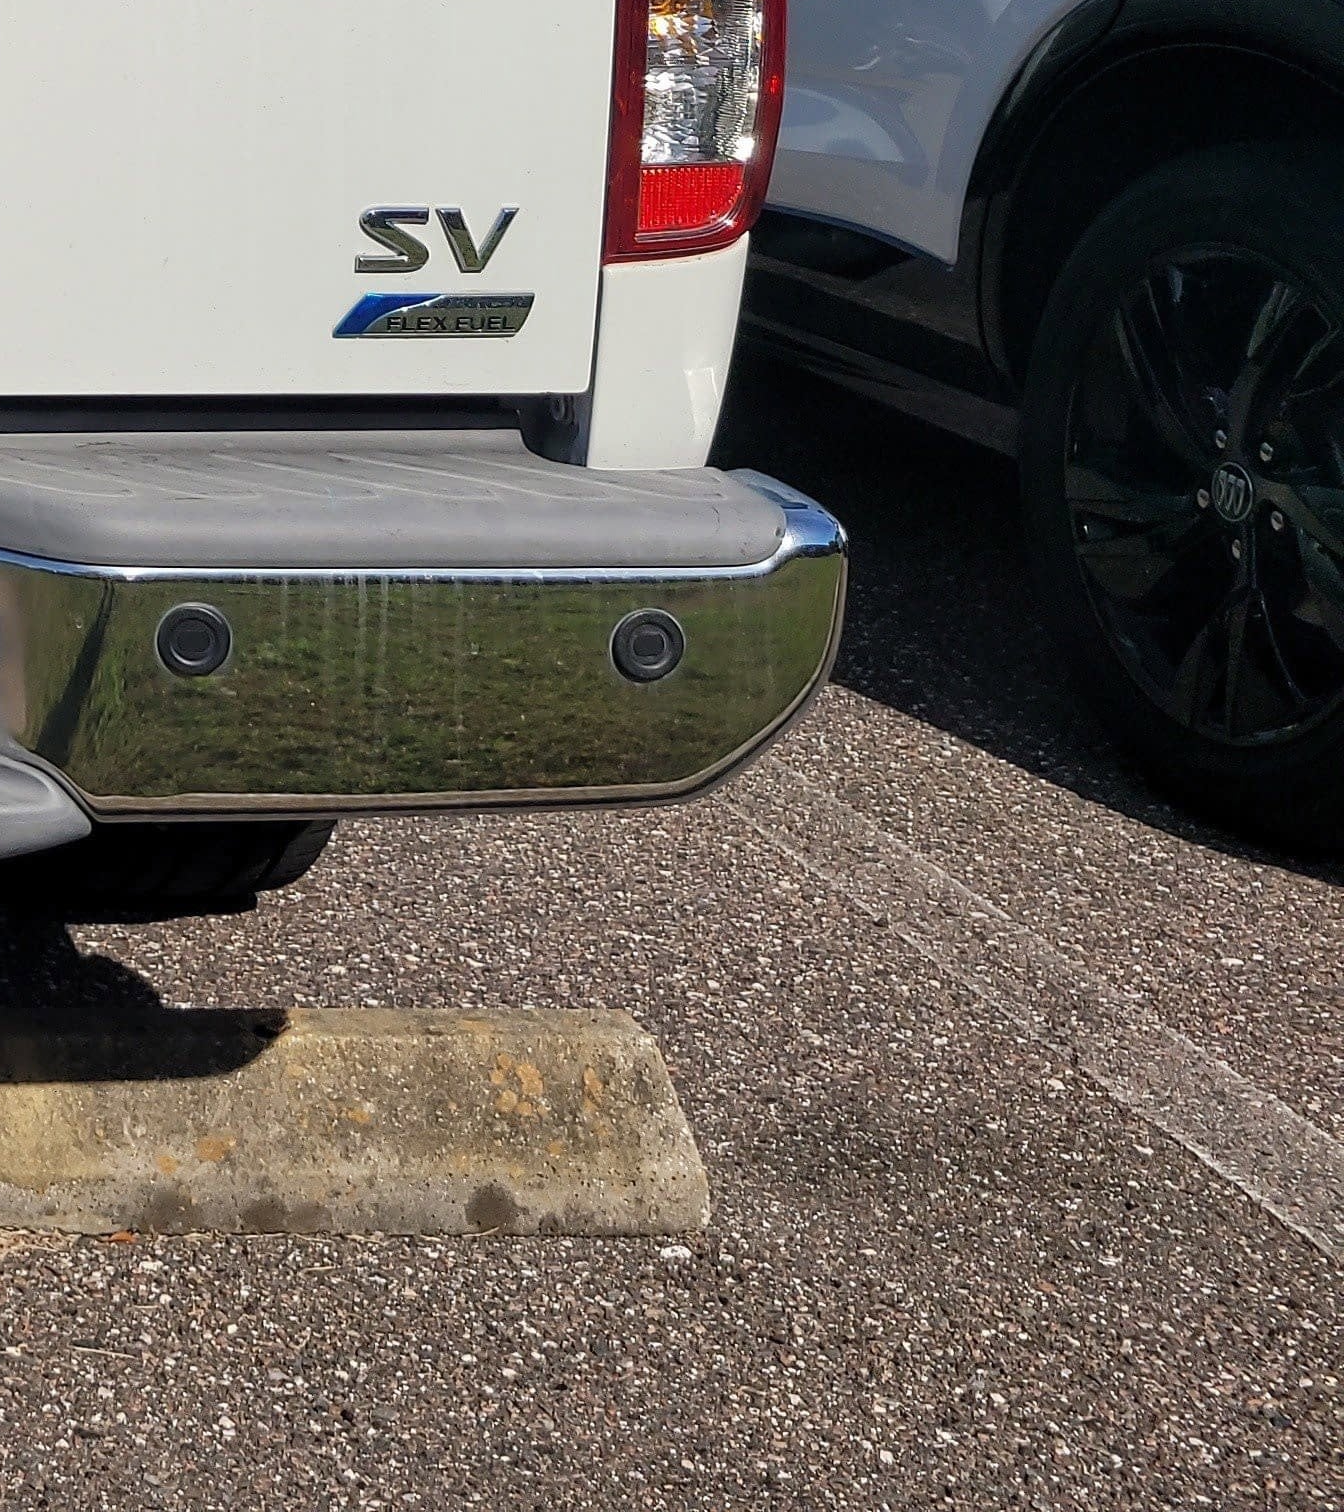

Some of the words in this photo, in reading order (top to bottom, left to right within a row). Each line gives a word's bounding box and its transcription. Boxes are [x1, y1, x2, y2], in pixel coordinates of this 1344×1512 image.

[353, 205, 520, 273] SV
[385, 315, 448, 332] FLEX
[454, 315, 516, 332] FUEL
